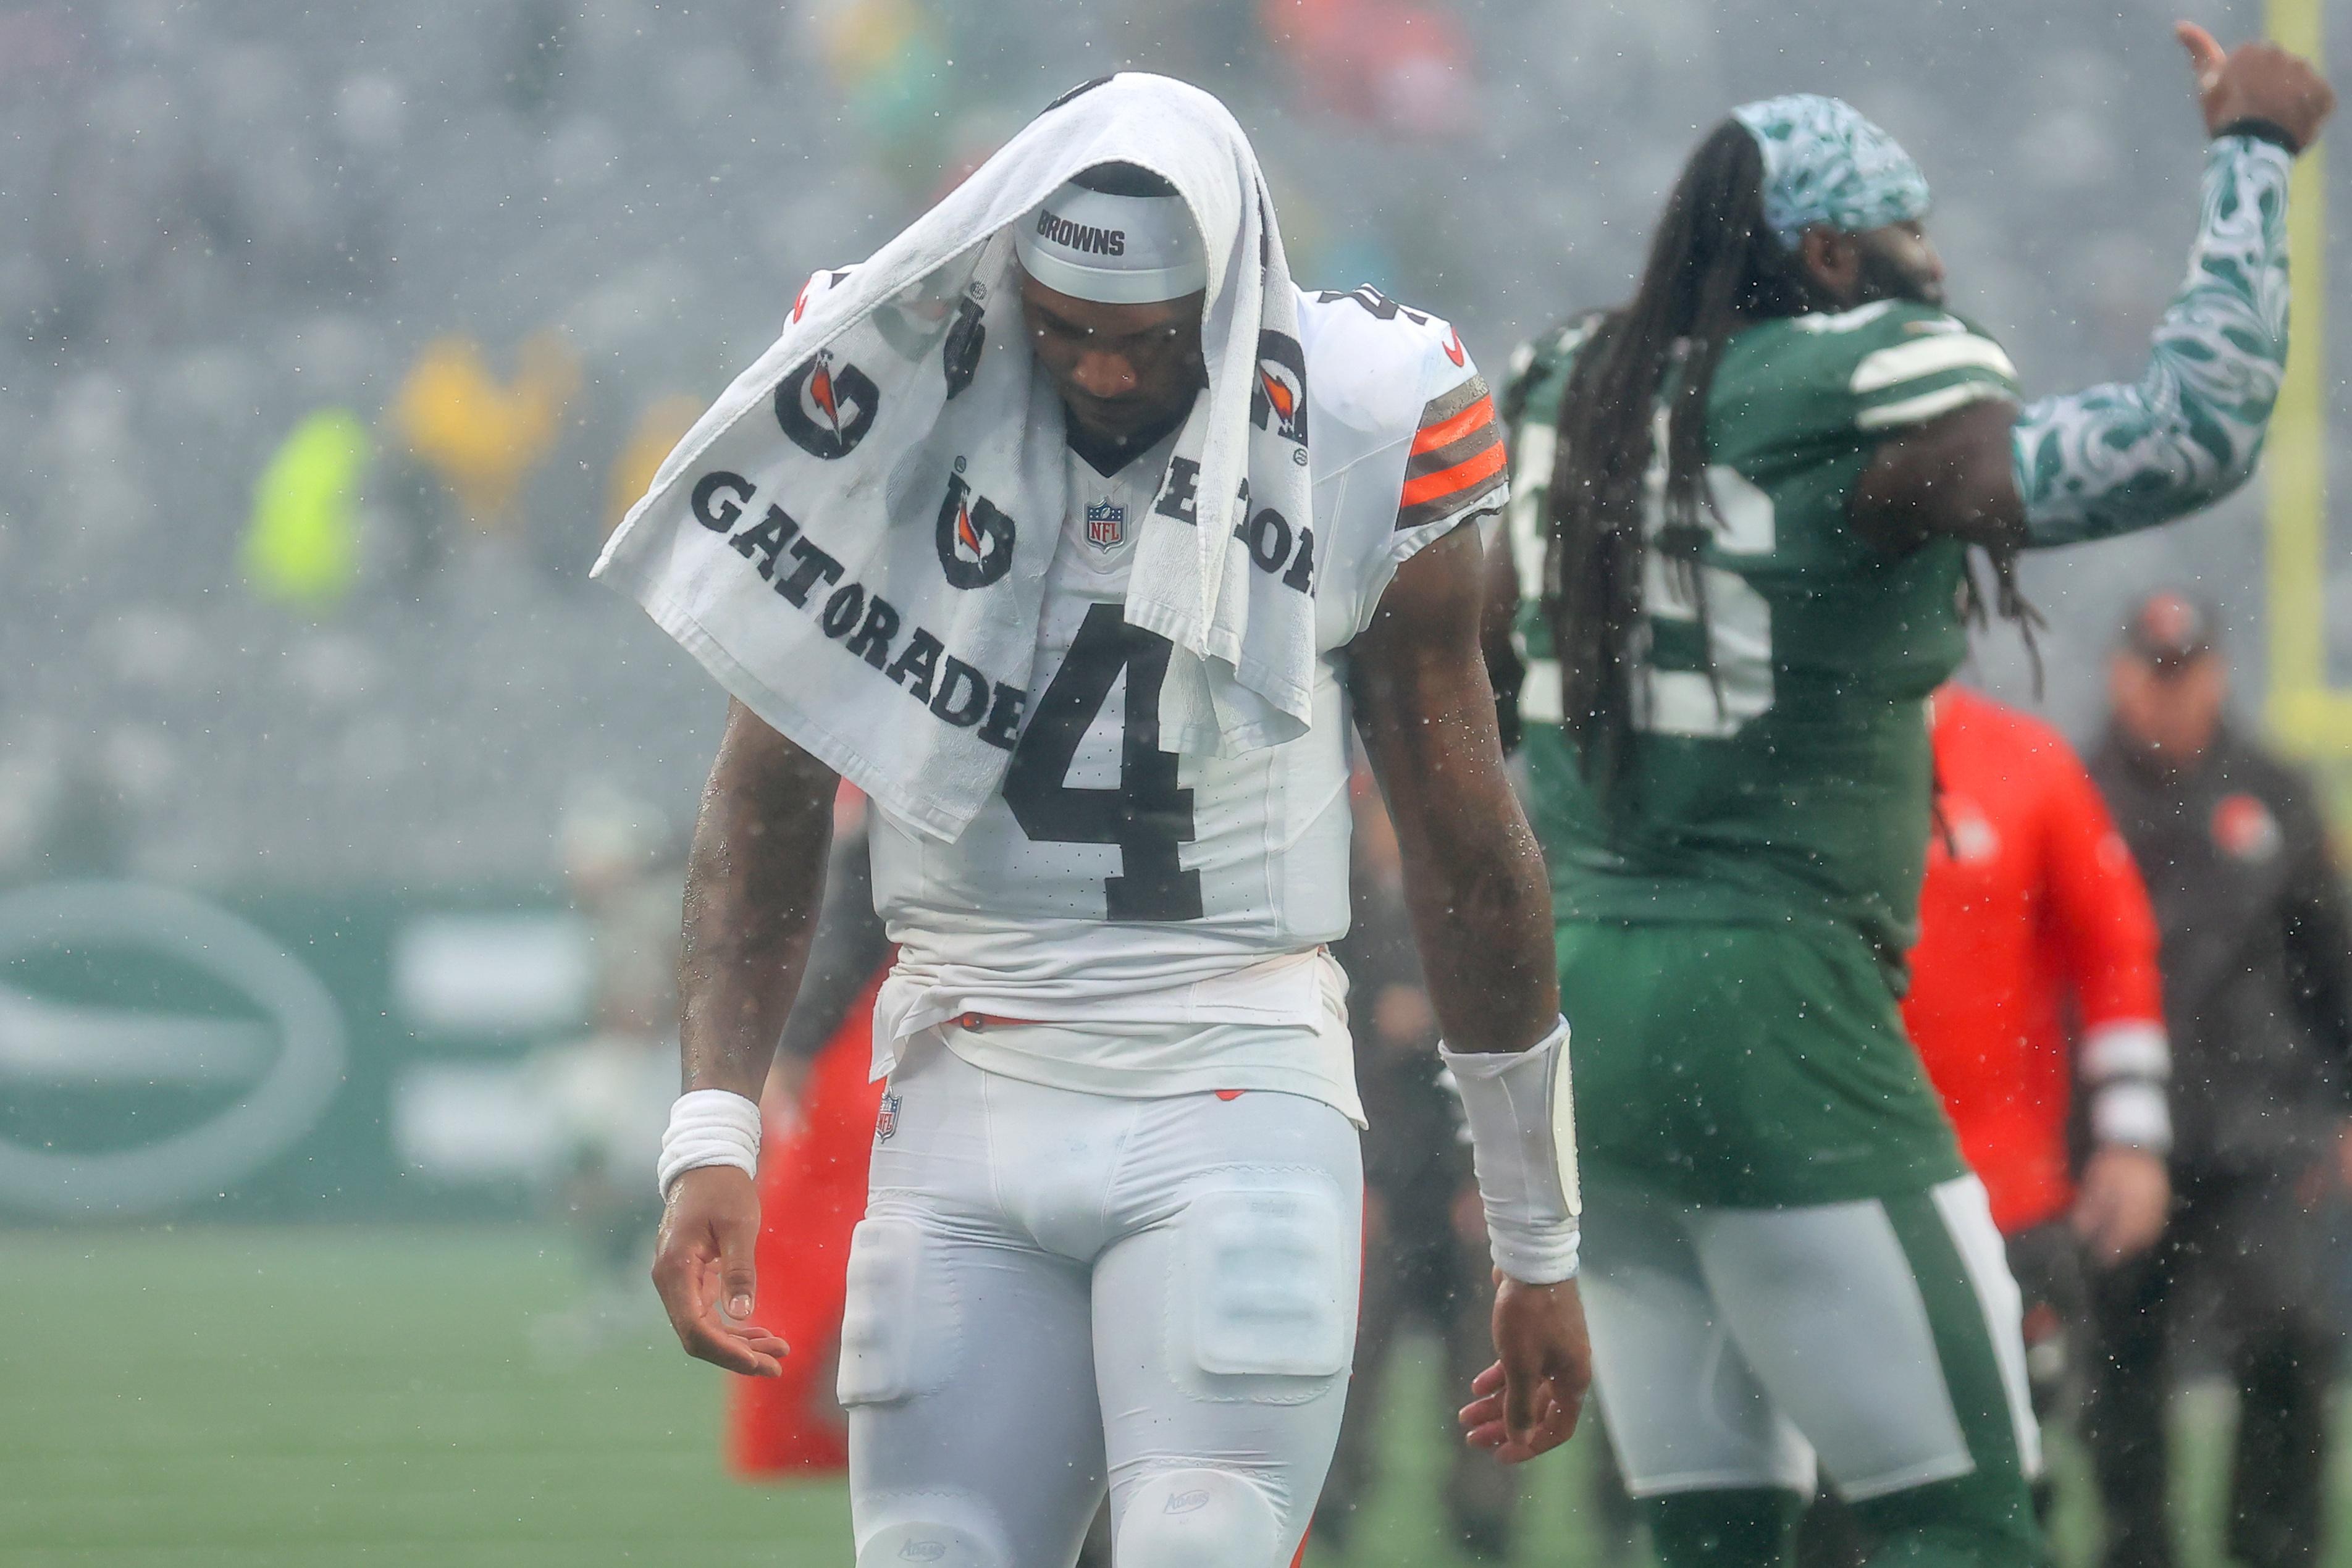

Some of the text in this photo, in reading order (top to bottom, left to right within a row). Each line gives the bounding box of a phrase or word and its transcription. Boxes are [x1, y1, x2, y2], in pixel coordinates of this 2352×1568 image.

[1036, 209, 1125, 256] BROWNS
[1091, 522, 1120, 541] NFL
[691, 471, 1027, 752] GATORADE
[1002, 603, 1203, 921] 4
[878, 1113, 893, 1133] NFL
